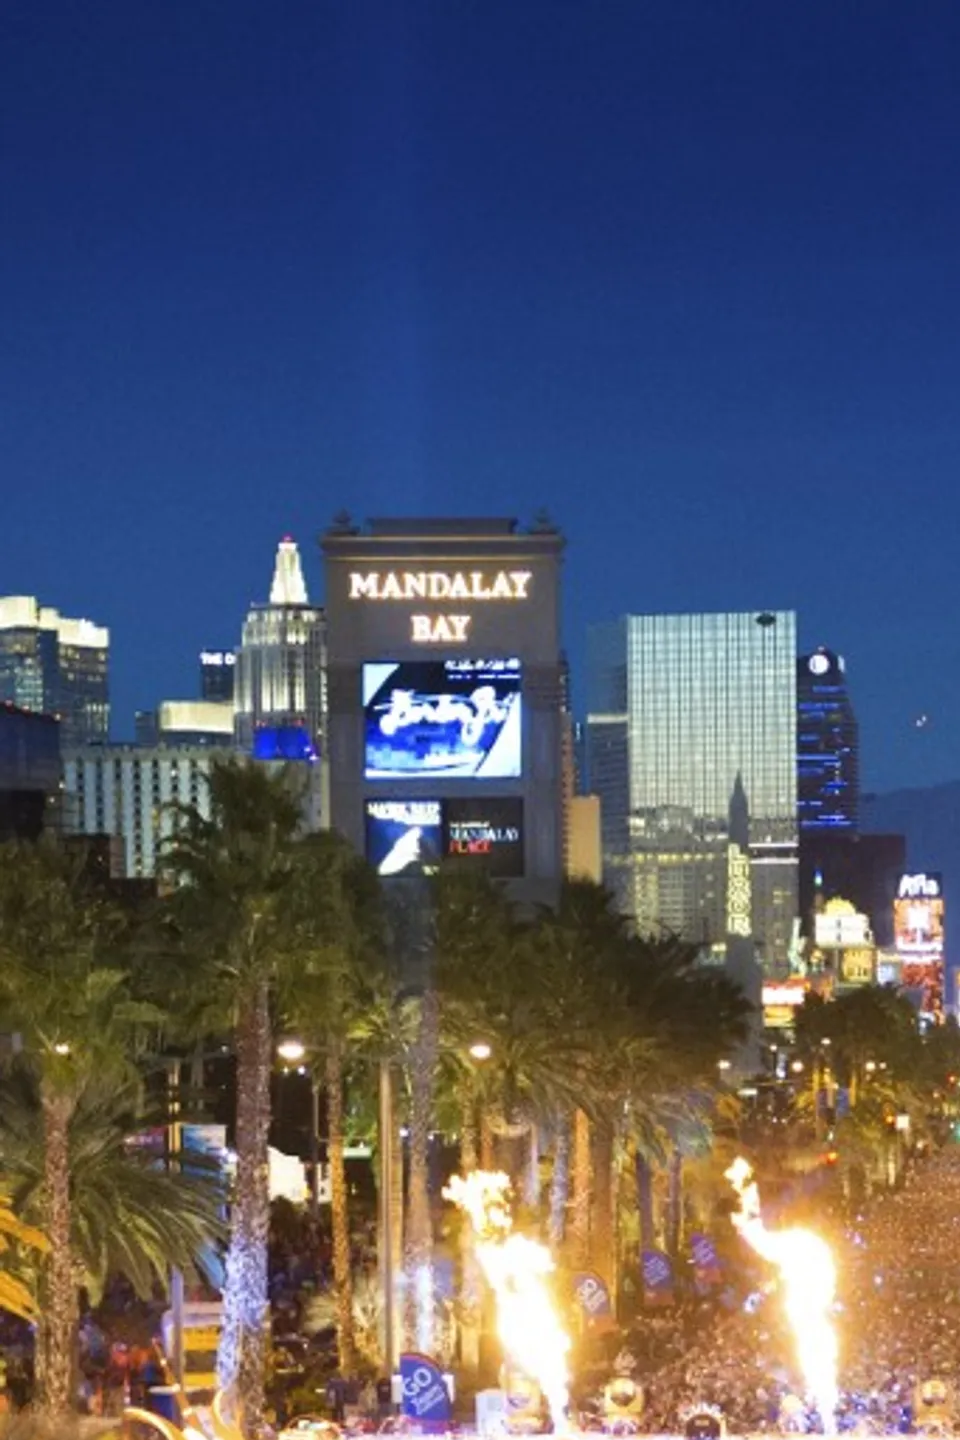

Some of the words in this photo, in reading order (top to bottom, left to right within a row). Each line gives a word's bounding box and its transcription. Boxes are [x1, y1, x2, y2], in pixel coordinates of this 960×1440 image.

[349, 571, 532, 599] MANDALAY
[410, 614, 471, 642] BAY
[404, 1367, 432, 1396] GO
